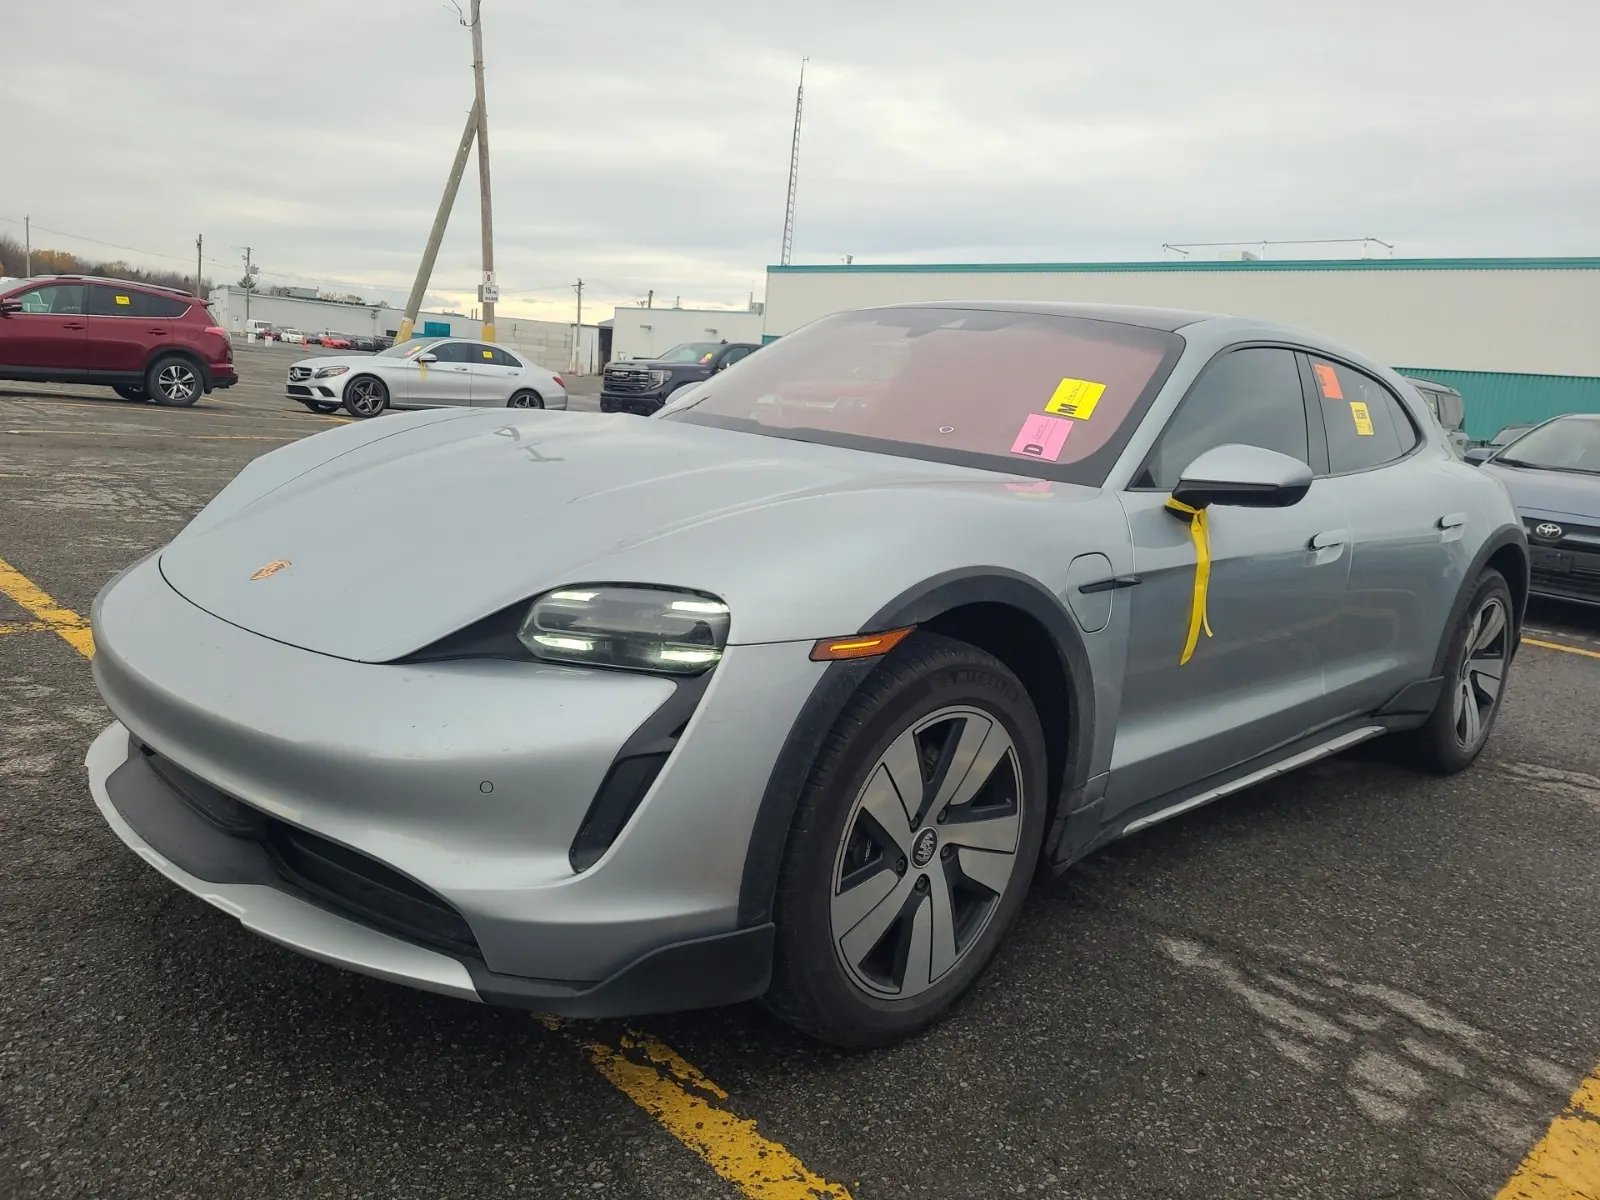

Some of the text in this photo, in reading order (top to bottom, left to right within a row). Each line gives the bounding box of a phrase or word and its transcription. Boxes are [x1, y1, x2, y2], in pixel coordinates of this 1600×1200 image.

[486, 287, 492, 295] 15
[1057, 403, 1078, 415] M
[1022, 443, 1043, 455] D
